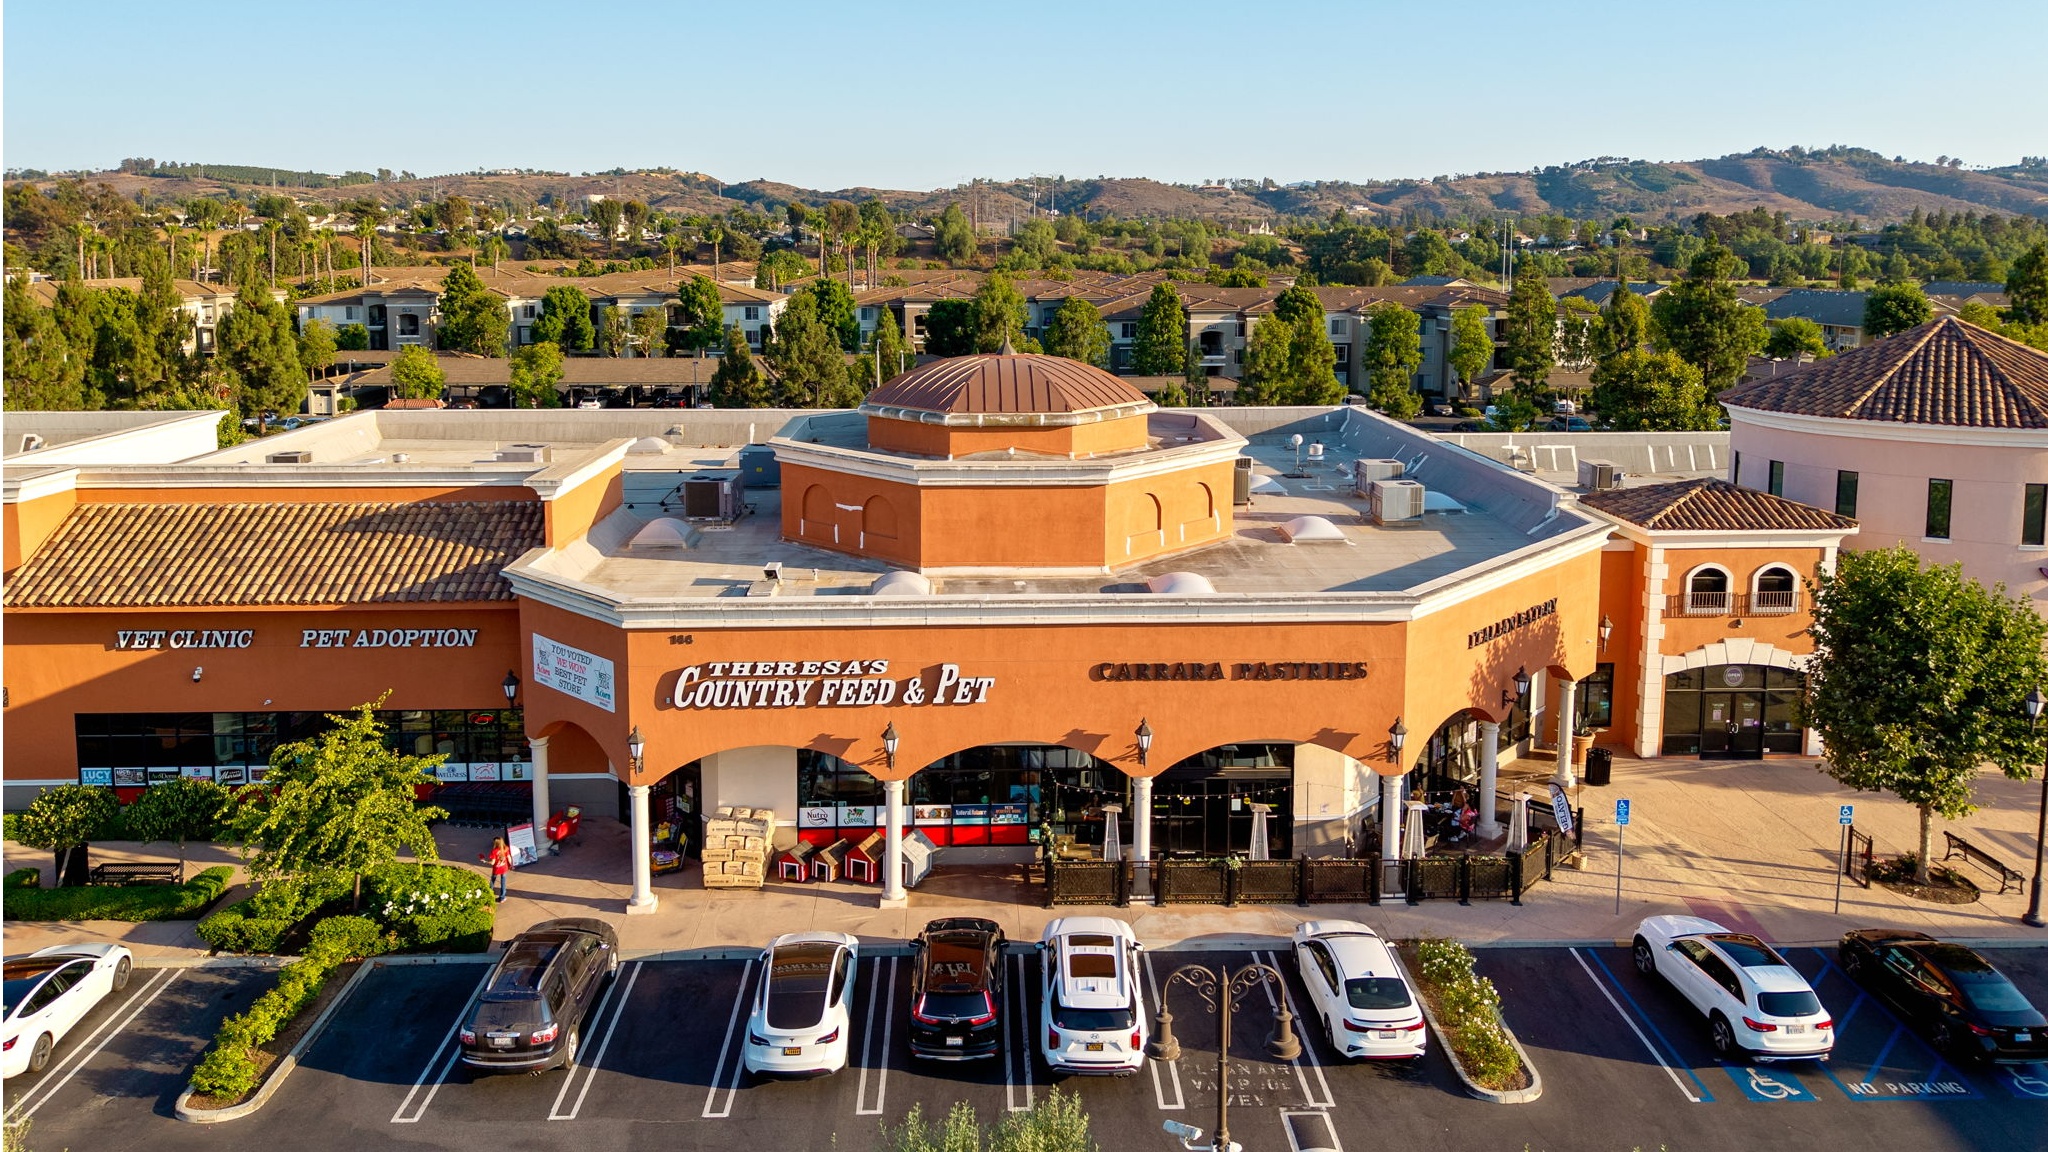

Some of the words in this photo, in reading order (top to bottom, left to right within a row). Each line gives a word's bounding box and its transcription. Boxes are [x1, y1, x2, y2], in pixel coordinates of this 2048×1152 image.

[1517, 597, 1558, 628] EATERY
[117, 630, 166, 648] VET
[169, 630, 254, 648] CLINIC
[300, 629, 350, 648] PET
[352, 629, 478, 647] ADOPTION
[552, 644, 566, 657] YOU
[556, 656, 567, 668] WE
[708, 660, 889, 677] THERESA'S
[555, 667, 573, 680] BEST
[573, 674, 588, 686] PET
[1098, 661, 1226, 681] CARRARA
[1236, 661, 1369, 680] PASTRIES
[558, 678, 582, 695] STORE
[674, 665, 815, 708] COUNTRY
[817, 678, 897, 706] FEED
[902, 676, 925, 704] &
[932, 663, 996, 704] PET
[83, 770, 111, 780] LUCY
[807, 811, 829, 819] Nutro
[1556, 795, 1569, 830] GELATO
[1846, 1082, 1879, 1095] NO
[1884, 1082, 1967, 1095] PARKING
